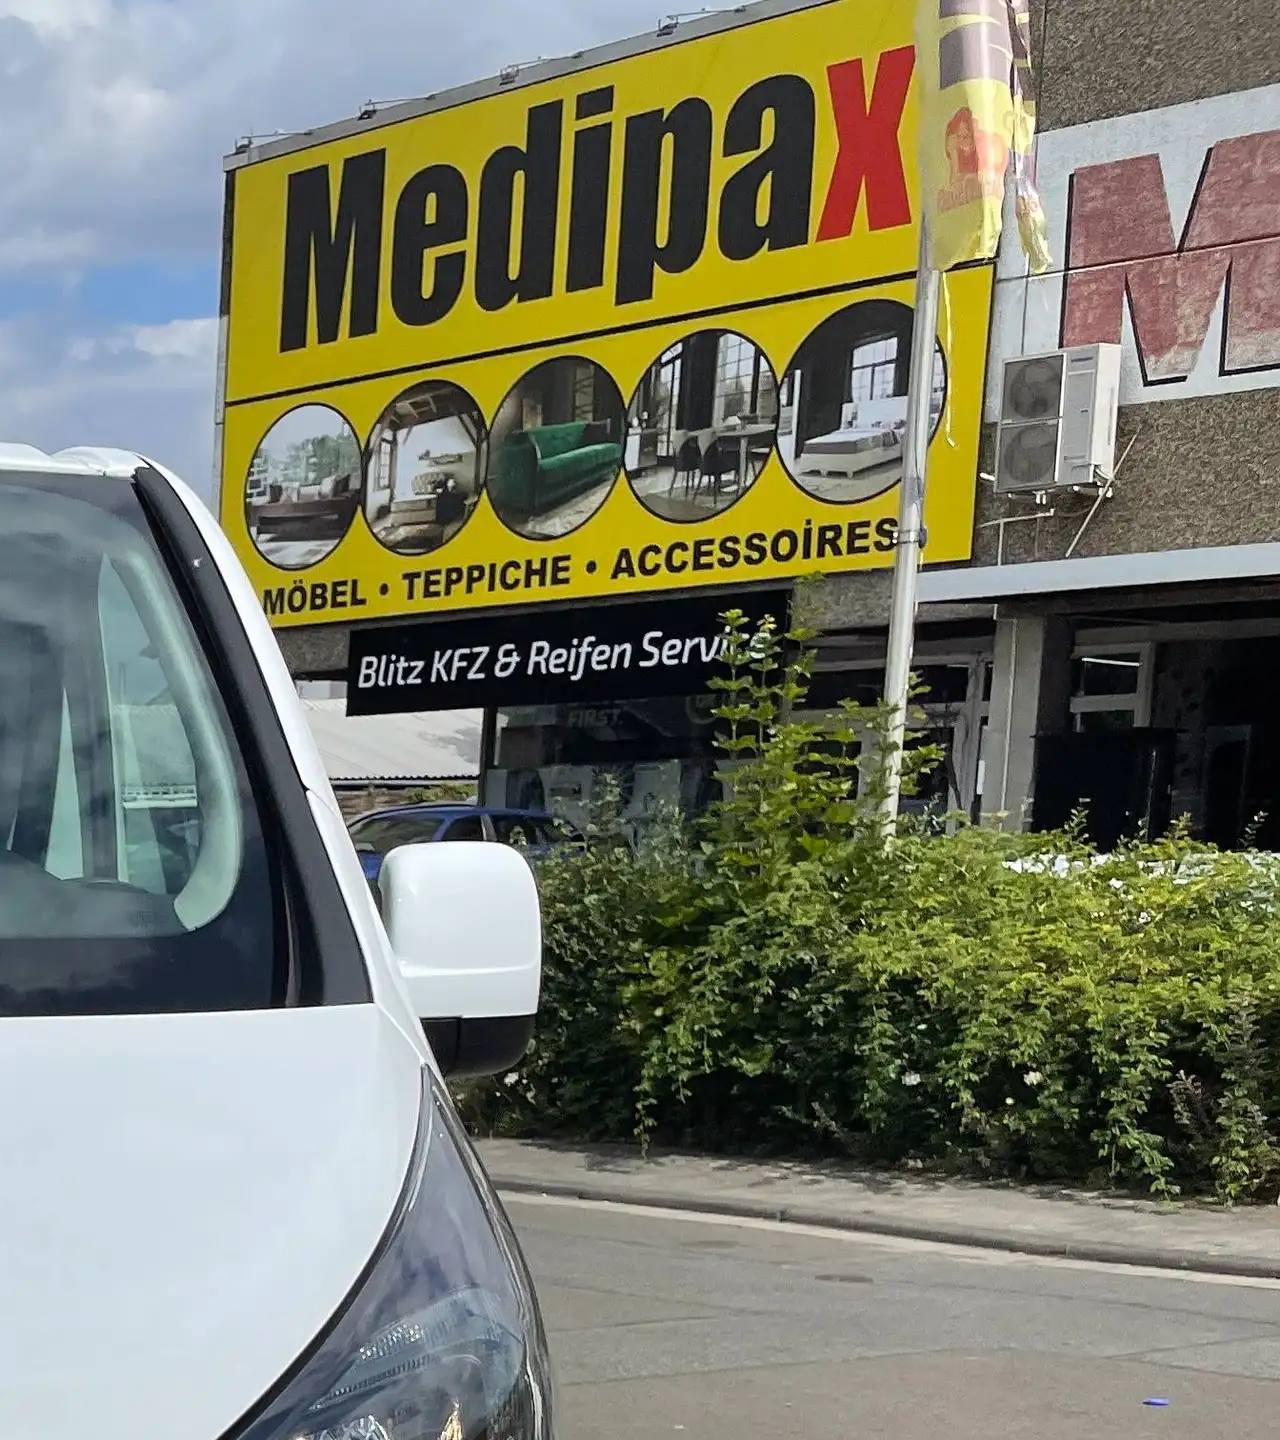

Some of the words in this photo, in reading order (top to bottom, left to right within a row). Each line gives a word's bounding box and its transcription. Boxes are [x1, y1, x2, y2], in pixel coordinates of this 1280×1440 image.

[279, 44, 916, 353] Medipax
[262, 576, 367, 616] MÖBEL
[402, 555, 572, 601] TEPPICHE
[357, 655, 424, 689] Blitz
[430, 646, 491, 683] KFZ
[494, 643, 521, 679] &
[527, 636, 633, 682] Reifen
[638, 626, 772, 669] Servie
